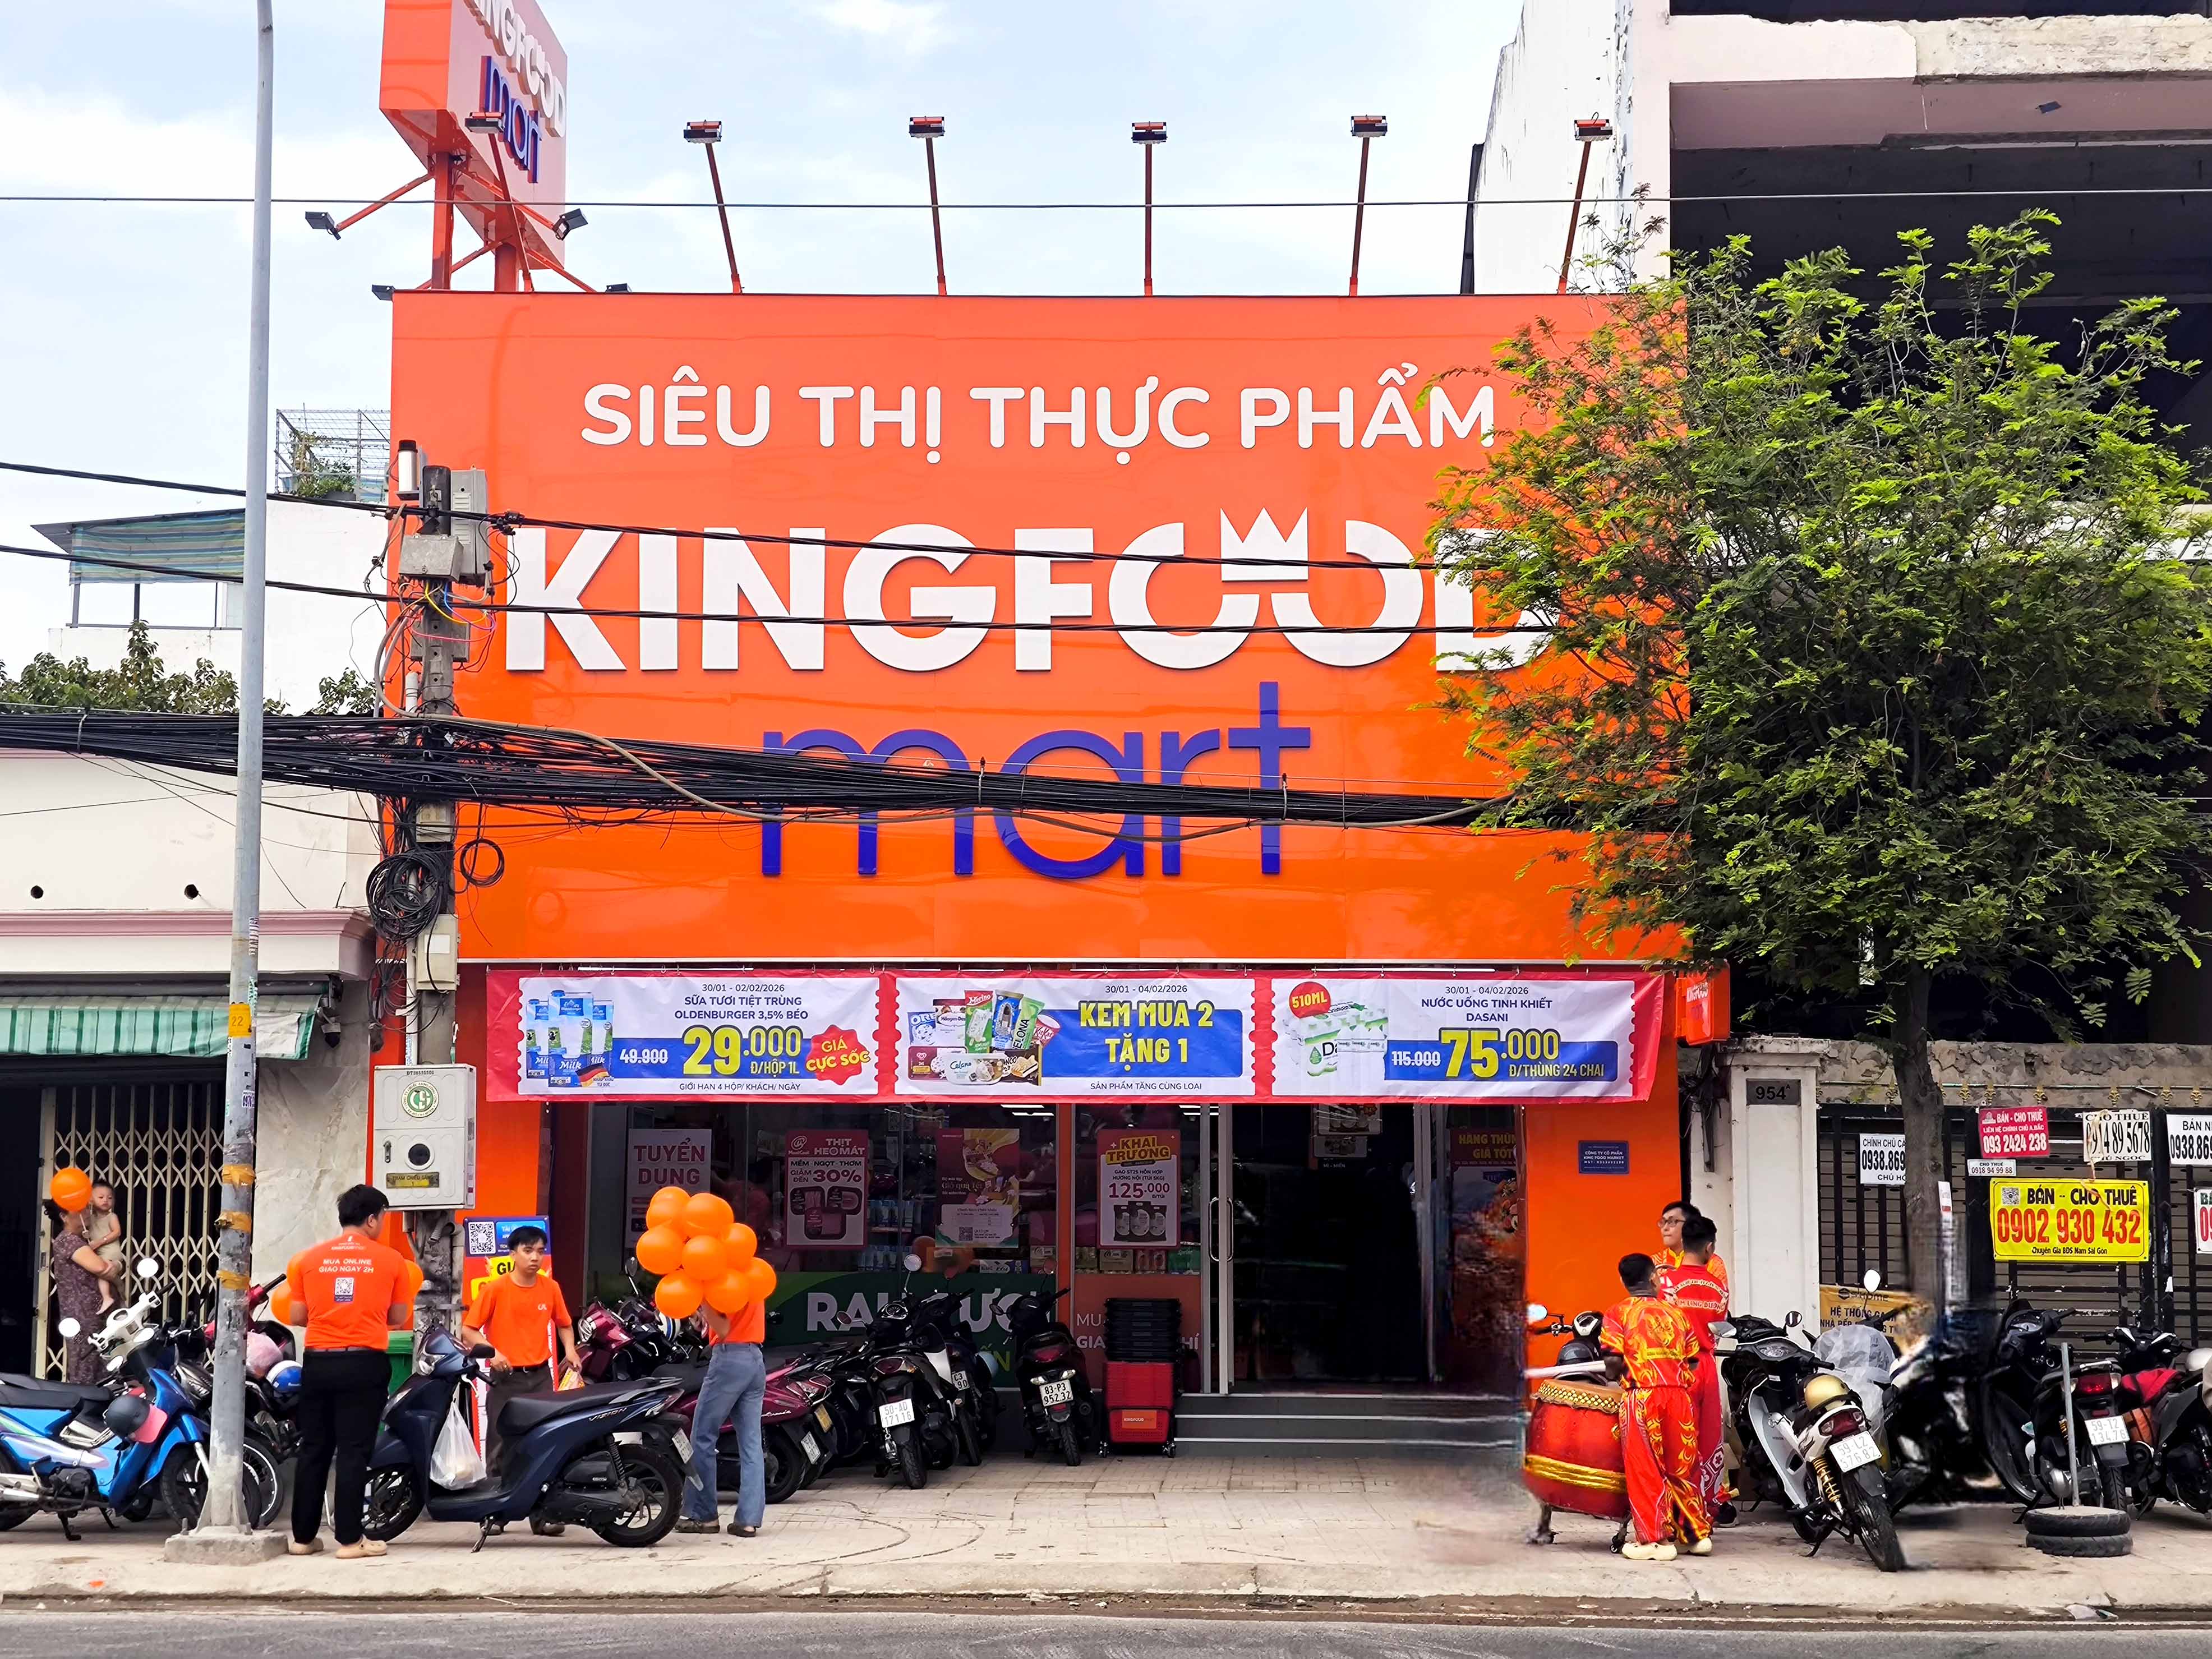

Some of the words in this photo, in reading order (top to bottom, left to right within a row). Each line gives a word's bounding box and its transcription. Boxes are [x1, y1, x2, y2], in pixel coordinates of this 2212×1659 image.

[481, 56, 542, 183] mart
[581, 365, 771, 446] SIÊU
[799, 385, 941, 464] THỊ
[970, 376, 1210, 465] THỰC
[1241, 362, 1495, 449] PHẨM
[504, 513, 1561, 673] KINGFOOD
[762, 681, 1310, 879] mart
[685, 995, 707, 1006] SỮA
[709, 996, 735, 1006] TƯƠI
[739, 995, 762, 1007] TIỆT
[764, 995, 801, 1006] TRÙNG
[969, 994, 991, 1004] Merino
[1292, 991, 1328, 1008] 510ML
[1422, 996, 1453, 1008] NƯỚC
[1456, 997, 1488, 1008] UỐNG
[1491, 999, 1518, 1008] TINH
[1521, 997, 1552, 1008] KHIẾT
[232, 1016, 243, 1026] 22
[675, 1010, 755, 1019] OLDENBURGER
[758, 1010, 784, 1020] 3,5%
[786, 1008, 808, 1019] BÉO
[911, 1014, 936, 1025] ORE
[1080, 1002, 1131, 1027] KEM
[1139, 1002, 1190, 1027] MUA
[1197, 1002, 1213, 1027] 2
[1466, 1013, 1508, 1022] DASANI
[1012, 1019, 1030, 1050] ELONA
[683, 1026, 802, 1076] 29.000
[821, 1036, 849, 1052] GIÁ
[619, 1048, 669, 1064] 49.900
[1105, 1033, 1170, 1071] TẶNG
[1178, 1038, 1187, 1063] 1
[1391, 1050, 1441, 1067] 115.000
[1441, 1030, 1560, 1078] 75.000
[559, 1061, 582, 1070] Milk
[750, 1059, 786, 1077] Đ/HỘP
[789, 1061, 799, 1074] 1L
[805, 1054, 836, 1073] CỰC
[840, 1048, 870, 1066] SỐC
[1509, 1061, 1560, 1077] Đ/THÙNG
[1563, 1064, 1578, 1077] 24
[1580, 1064, 1604, 1077] CHAI
[679, 1081, 695, 1090] GIỚI
[746, 1082, 777, 1091] KHÁCH/
[779, 1082, 800, 1091] NGÀY
[1159, 1081, 1181, 1090] CÙNG
[1996, 1111, 2009, 1123] BÁN
[2014, 1112, 2026, 1122] CHO
[2027, 1109, 2043, 1122] THUÊ
[2117, 1110, 2149, 1121] THUÊ
[2182, 1118, 2202, 1131] BÁN
[826, 1139, 852, 1148] THỊT
[1121, 1137, 1155, 1149] KHAI
[1490, 1132, 1517, 1145] THÙN
[1863, 1137, 1881, 1147] CHÍNH
[1883, 1137, 1896, 1148] CHỦ
[1983, 1135, 2001, 1154] 093
[2003, 1133, 2026, 1153] 2424
[2029, 1132, 2047, 1151] 238
[2112, 1122, 2123, 1154] 89
[2127, 1121, 2150, 1154] 5678
[634, 1137, 705, 1162] TUYỂN
[840, 1146, 865, 1155] MÁT
[1107, 1147, 1169, 1162] TRƯƠNG
[2169, 1135, 2212, 1159] 0938.869
[1862, 1150, 1905, 1170] 0938.869
[813, 1169, 862, 1182] 30%
[1109, 1182, 1170, 1199] 125.000
[2027, 1185, 2055, 1205] BÁN
[2071, 1188, 2099, 1205] CHO
[2104, 1185, 2138, 1205] THUÊ
[1997, 1208, 2050, 1243] 0902
[2057, 1209, 2095, 1243] 930
[2102, 1209, 2141, 1243] 432
[1831, 1306, 1841, 1316] HỆ
[1077, 1314, 1105, 1327] MU
[1077, 1335, 1105, 1349] GIA
[1044, 1382, 1067, 1395] 83-P3
[1044, 1391, 1071, 1404] 952.32
[589, 1407, 627, 1422] VISION
[884, 1402, 908, 1415] 50-AD
[885, 1411, 912, 1426] 171.16
[2091, 1418, 2119, 1431] 59-T2
